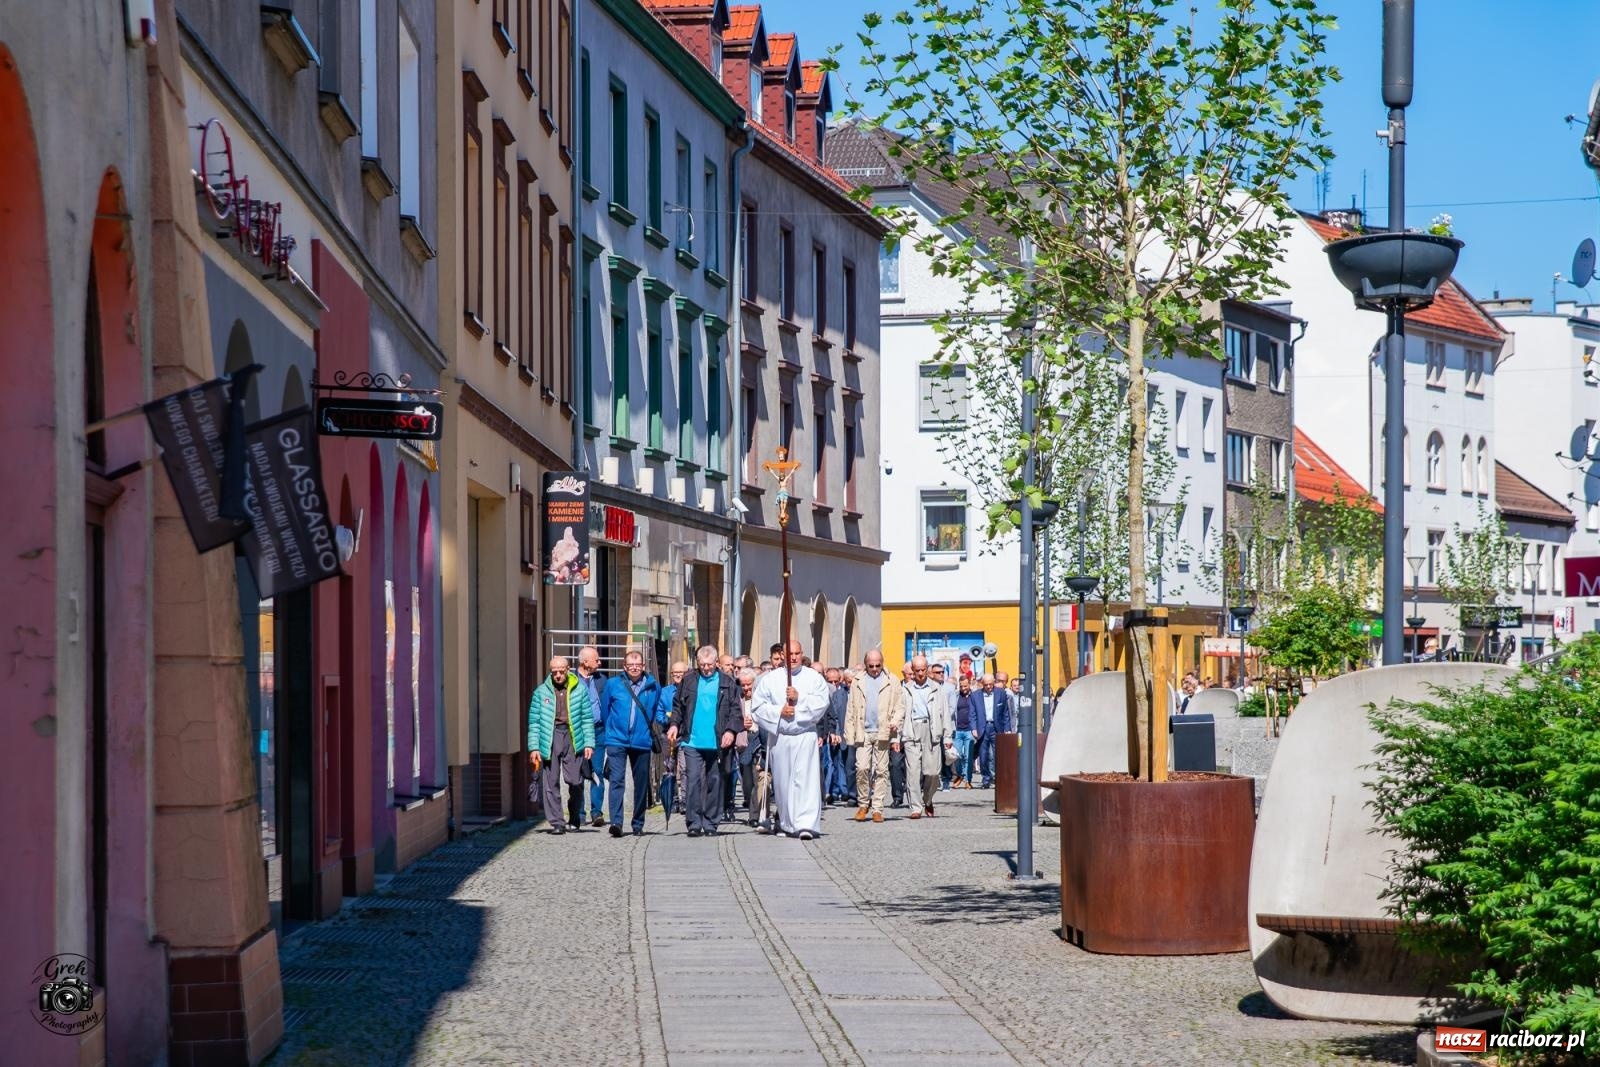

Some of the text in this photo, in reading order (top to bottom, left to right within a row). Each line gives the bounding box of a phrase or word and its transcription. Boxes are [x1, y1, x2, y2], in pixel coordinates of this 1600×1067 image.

[181, 446, 219, 523] CHARAKTERU
[250, 441, 273, 477] NADAJ
[261, 477, 291, 529] SWOJEMU
[277, 426, 339, 572] GLASSARIO
[548, 507, 584, 515] KAMIENIE
